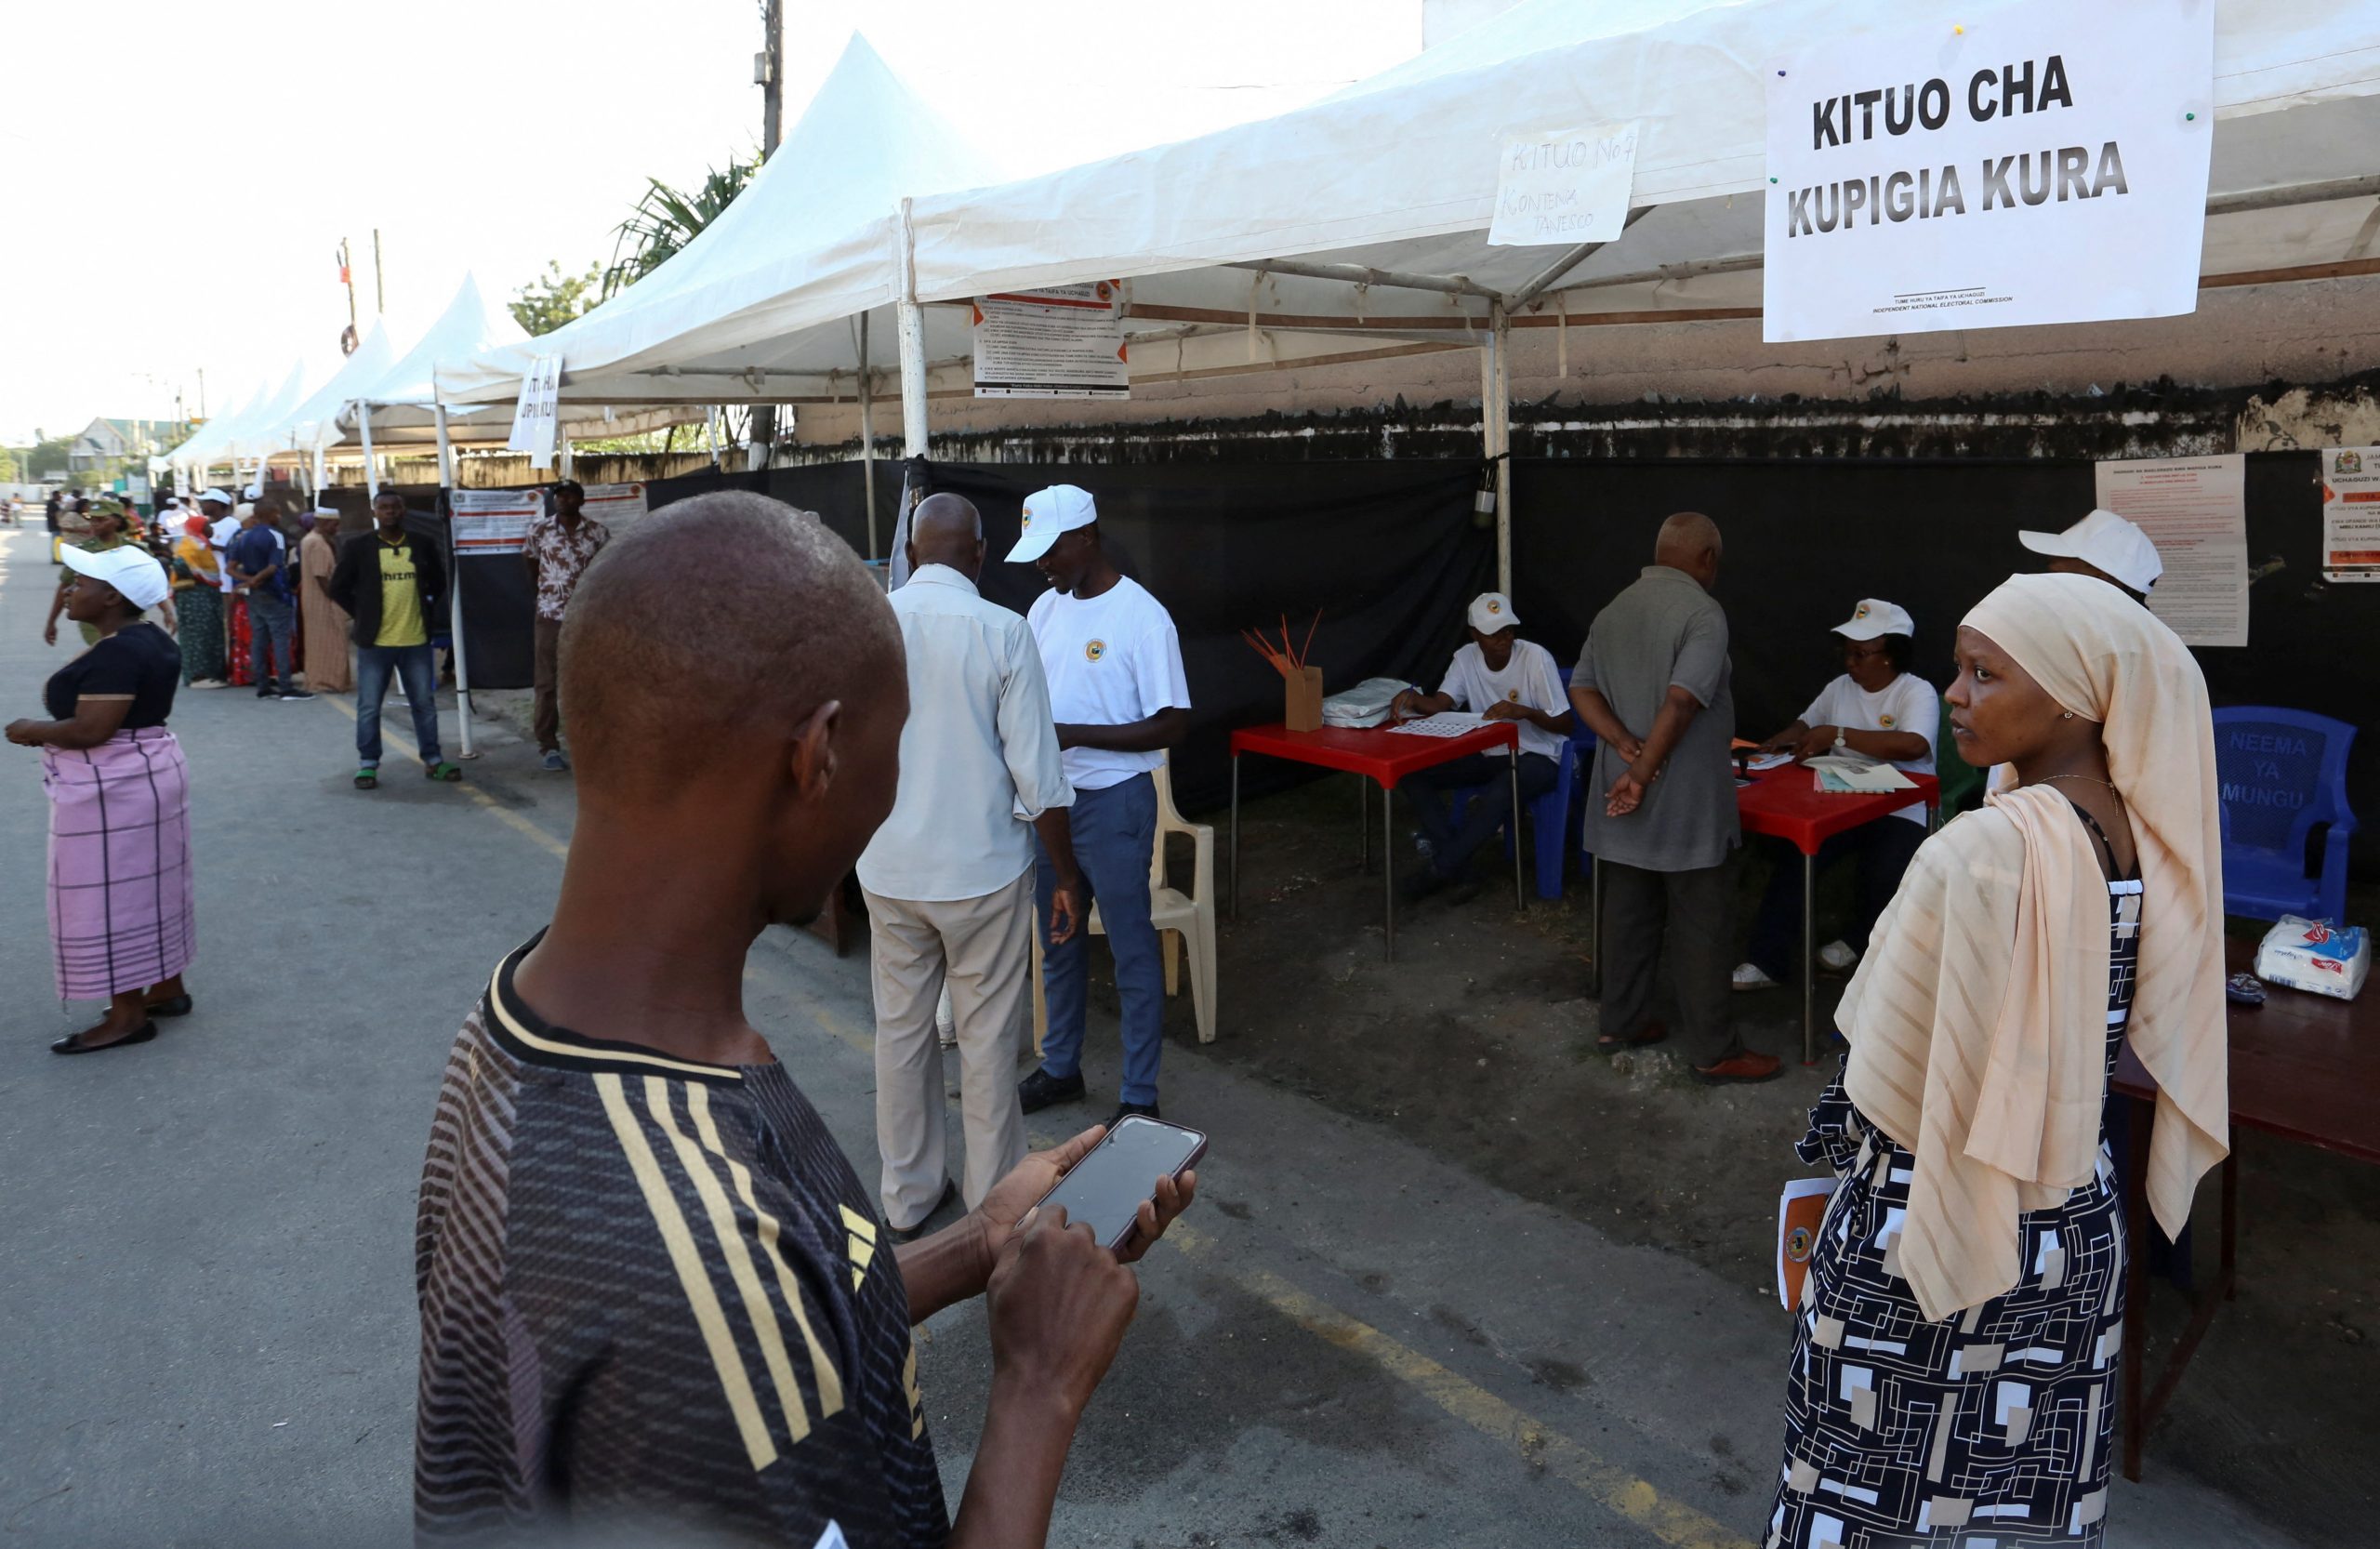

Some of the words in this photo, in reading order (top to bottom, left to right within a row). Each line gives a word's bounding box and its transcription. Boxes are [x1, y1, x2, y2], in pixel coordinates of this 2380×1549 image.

[1812, 78, 1950, 151] KITUO
[1967, 54, 2074, 123] CHA
[1512, 141, 1587, 171] KITUO
[1788, 165, 1966, 238] KUPIGIA
[1981, 140, 2129, 211] KURA
[1533, 213, 1593, 236] TANESCO
[1872, 305, 1911, 313] INDEPENDENT
[1911, 302, 1938, 311] NATIONAL
[1939, 299, 1974, 308] ELECTORAL
[1975, 296, 2014, 305] COMMISSION
[2231, 731, 2307, 757] NEEMA
[2252, 759, 2280, 779] YA
[2221, 782, 2304, 810] MUNGU
